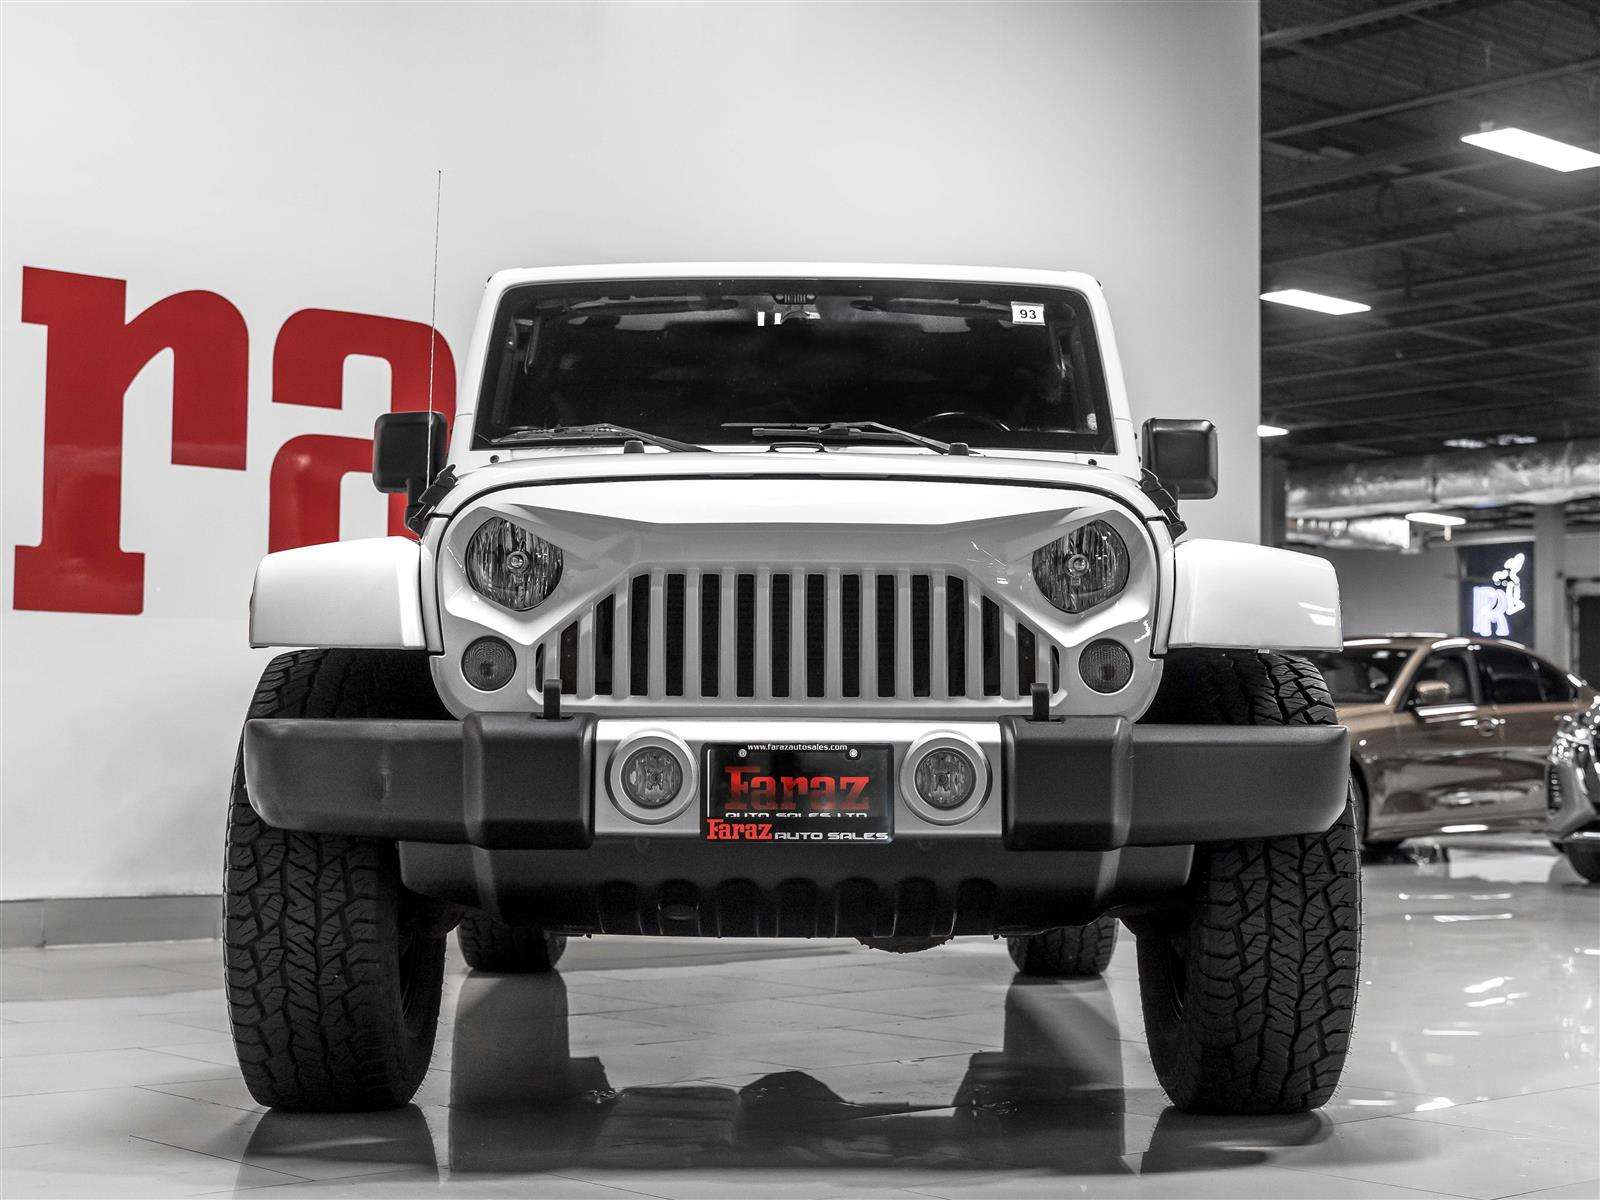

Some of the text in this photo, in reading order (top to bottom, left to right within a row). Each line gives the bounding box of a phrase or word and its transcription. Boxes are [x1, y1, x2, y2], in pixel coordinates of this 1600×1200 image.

[1020, 309, 1037, 320] 93
[747, 743, 848, 751] www.farazautosales.com
[724, 766, 871, 811] Faraz
[706, 818, 889, 840] Faraz AUTO SALES
